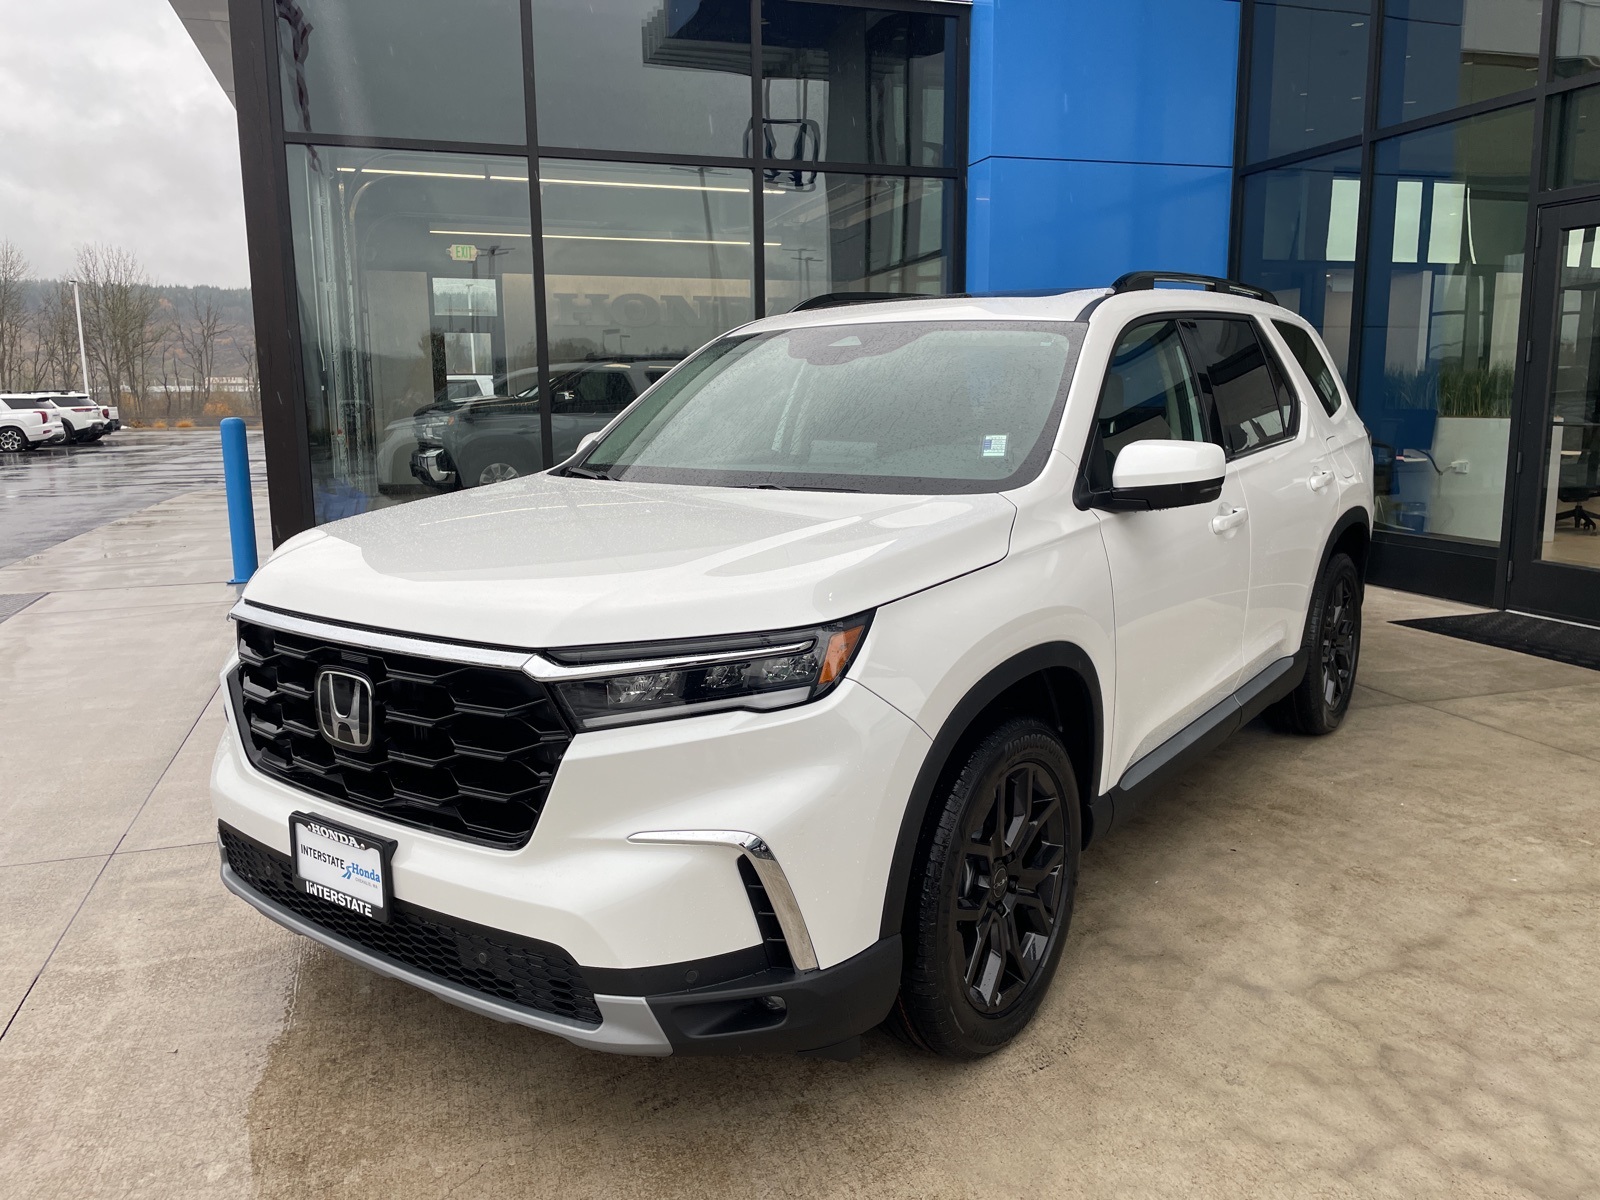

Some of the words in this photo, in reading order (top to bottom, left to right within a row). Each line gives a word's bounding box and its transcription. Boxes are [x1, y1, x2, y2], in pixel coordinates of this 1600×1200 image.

[455, 245, 472, 258] EXIT
[310, 823, 359, 849] HONDA
[301, 844, 345, 870] INTERSTATE
[352, 863, 380, 882] Honda
[306, 881, 373, 917] INTERSTATE
